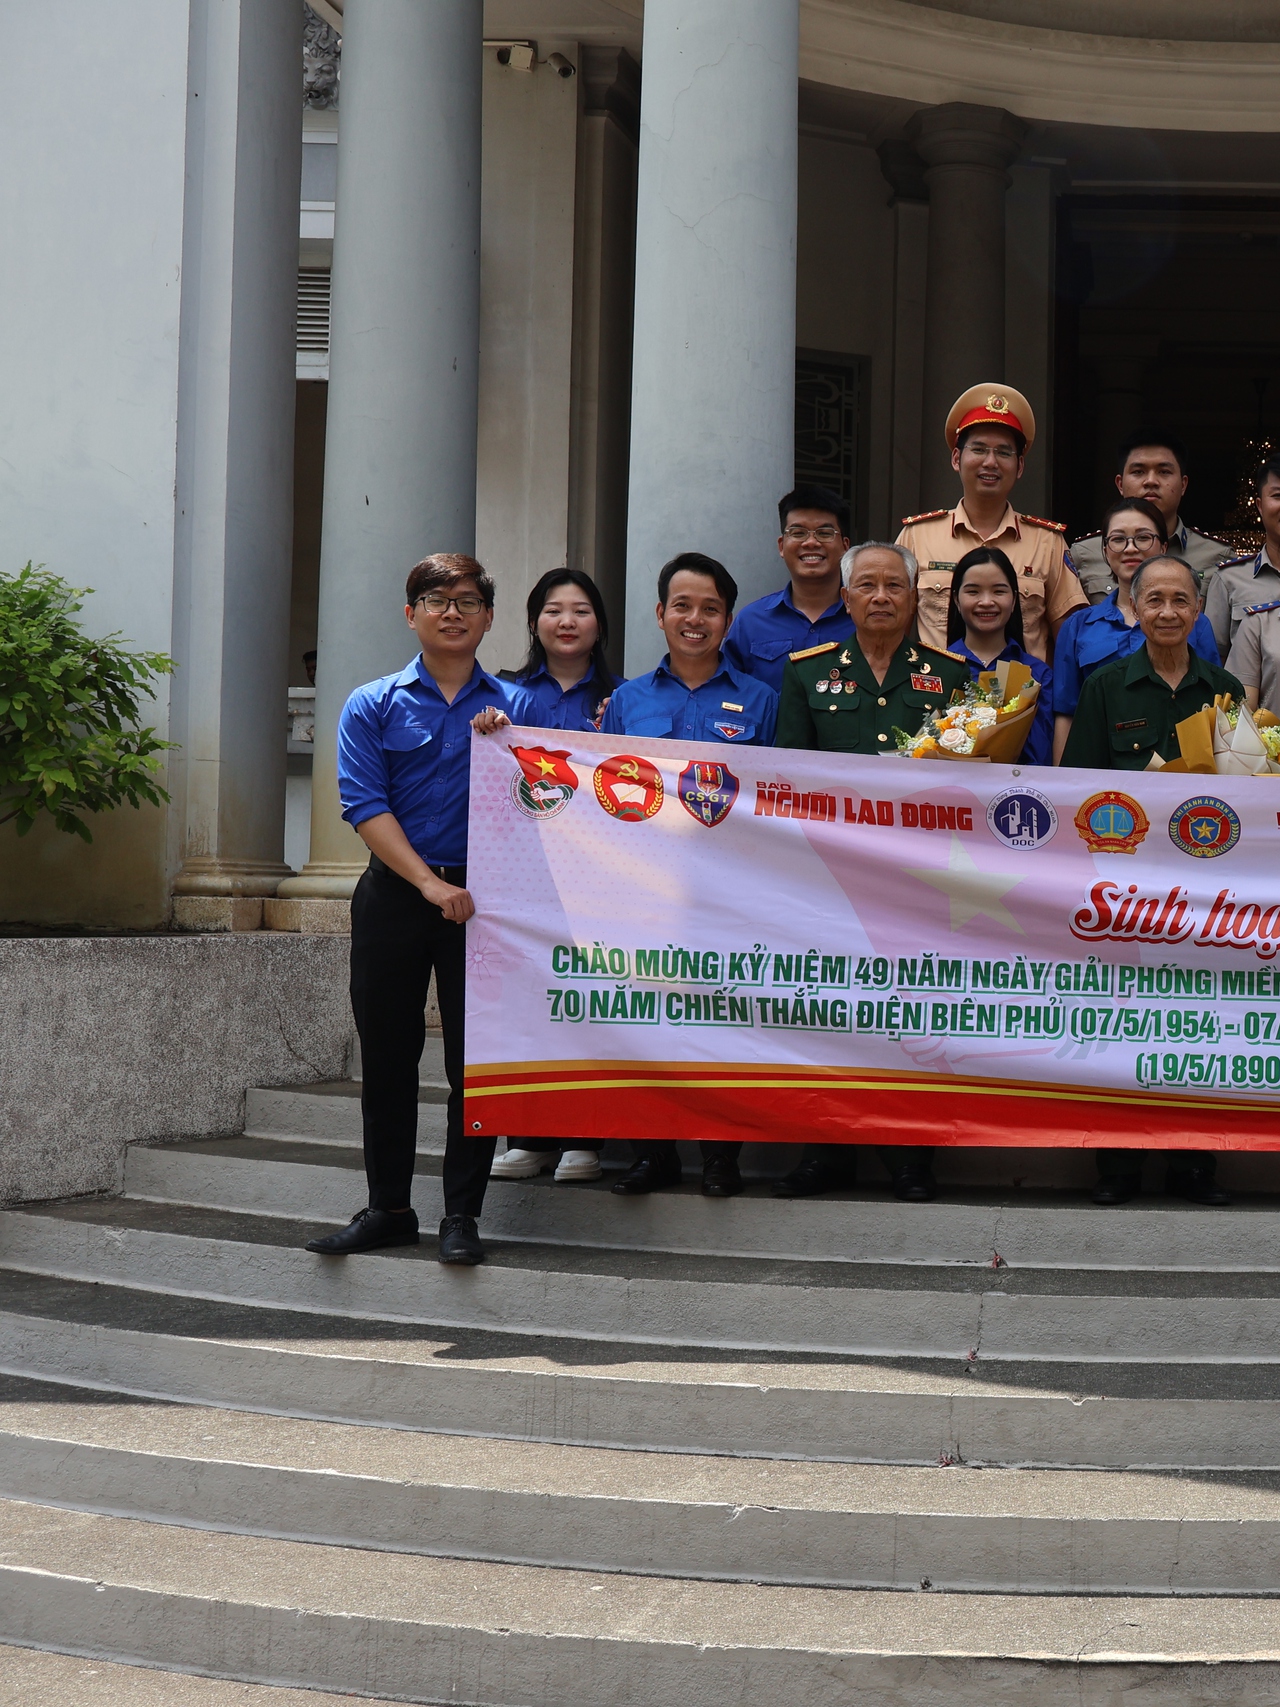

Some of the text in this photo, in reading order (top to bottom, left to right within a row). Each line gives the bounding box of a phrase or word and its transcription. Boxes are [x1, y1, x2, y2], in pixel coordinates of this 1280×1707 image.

[754, 791, 973, 831] NGƯỜI LAO ĐỘNG
[1174, 810, 1183, 819] THI
[1012, 839, 1035, 847] DOC
[1074, 880, 1194, 937] Sinh
[552, 941, 627, 976] CHÀO
[635, 943, 719, 980] MỪNG
[729, 943, 766, 982] KỶ
[773, 949, 846, 987] NIỆM
[855, 956, 888, 985] 49
[902, 952, 962, 987] NĂM
[971, 953, 1053, 988] NGÀY
[1055, 955, 1109, 991] GIẢI
[1119, 963, 1212, 996] PHÓNG
[548, 989, 579, 1018] 70
[589, 983, 657, 1020] NĂM
[665, 988, 747, 1022] CHIẾN
[758, 988, 849, 1029] THẮNG
[856, 994, 921, 1035] ĐIỆN
[931, 997, 997, 1032] BIÊN
[1005, 997, 1064, 1034] PHỦ
[1070, 1007, 1216, 1042] (07/5/1954
